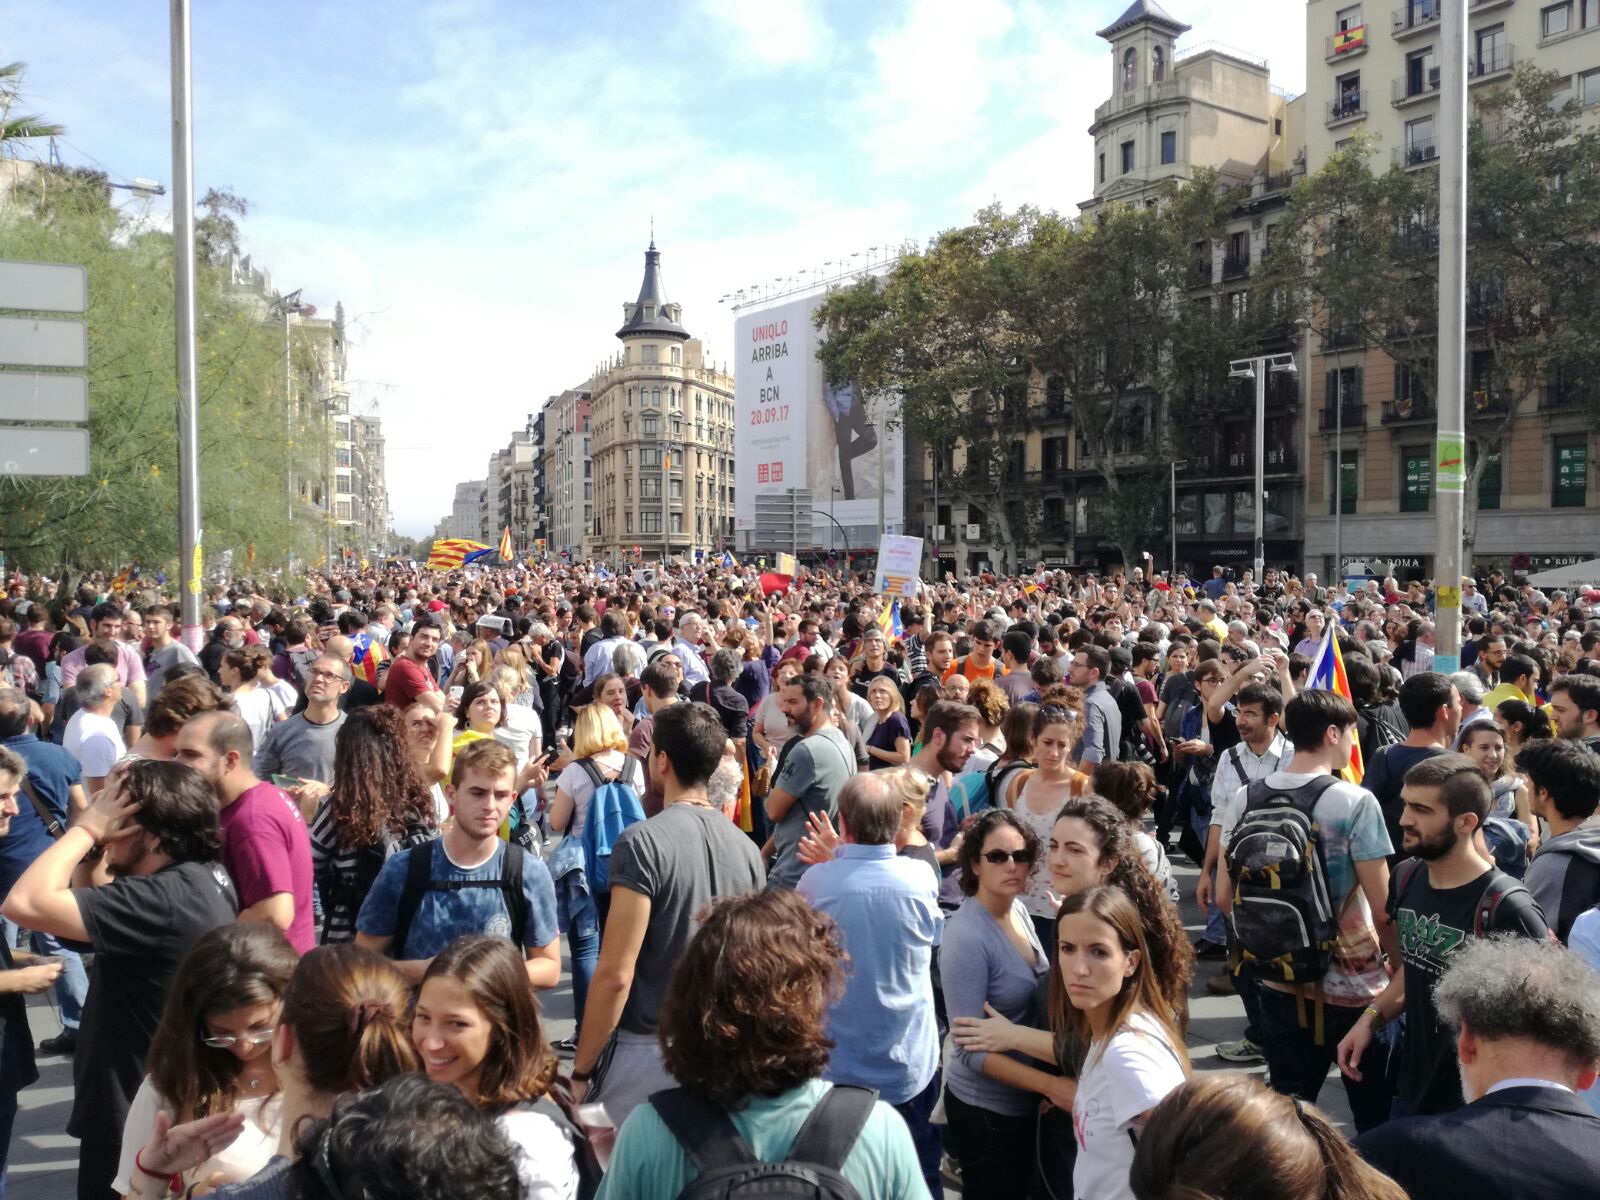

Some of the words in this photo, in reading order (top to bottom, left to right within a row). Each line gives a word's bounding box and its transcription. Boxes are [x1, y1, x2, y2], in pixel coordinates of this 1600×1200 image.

[752, 320, 788, 342] UNIQLO
[752, 341, 788, 363] ARRIBA
[766, 366, 773, 381] A
[760, 385, 780, 403] BCN
[751, 405, 789, 425] 20.09.17
